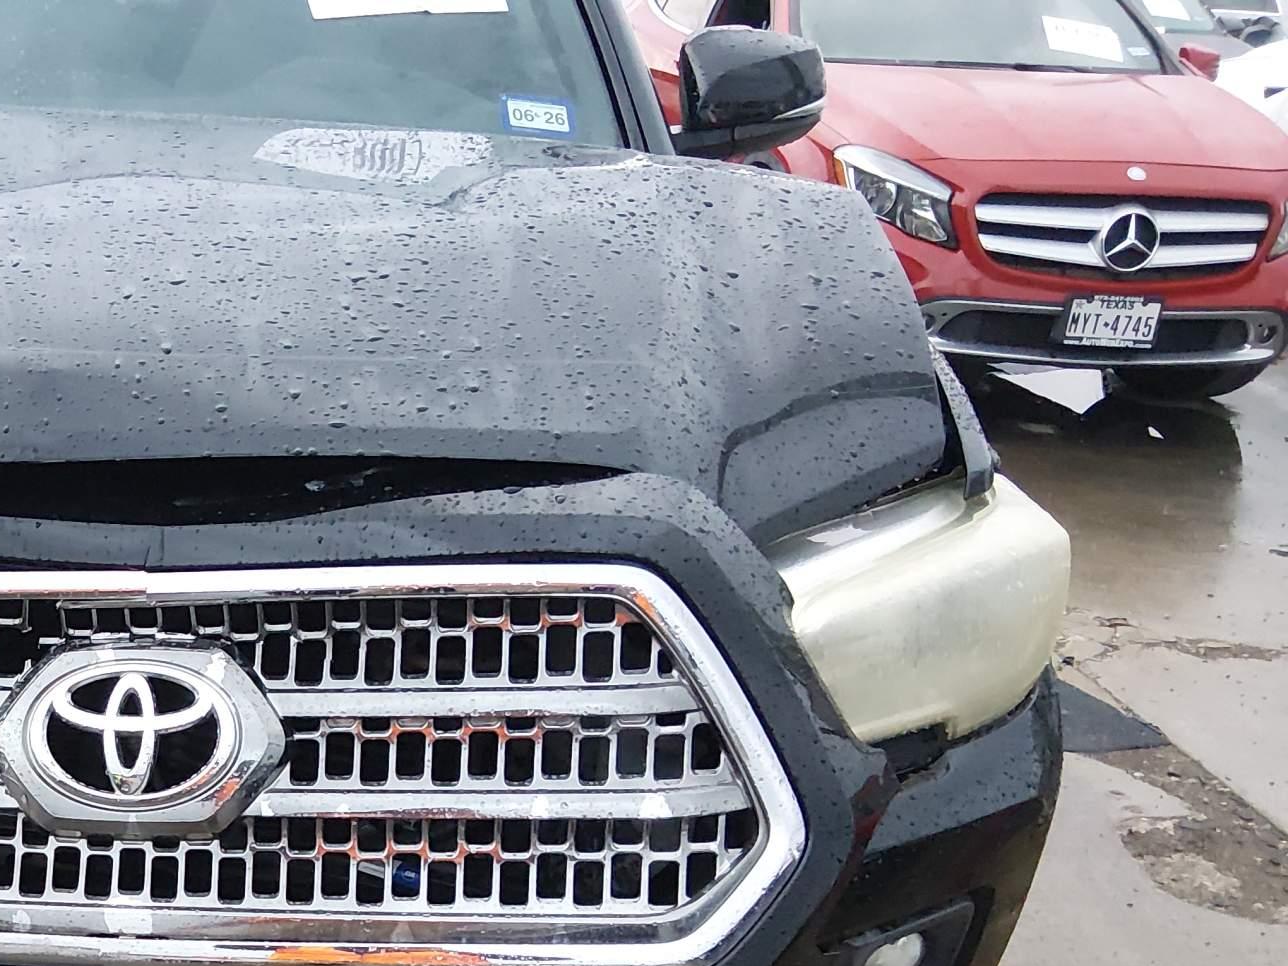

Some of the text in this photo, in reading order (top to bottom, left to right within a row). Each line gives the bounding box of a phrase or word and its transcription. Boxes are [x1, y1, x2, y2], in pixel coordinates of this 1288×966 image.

[512, 108, 566, 126] 06 26
[1099, 300, 1136, 311] TEXAS
